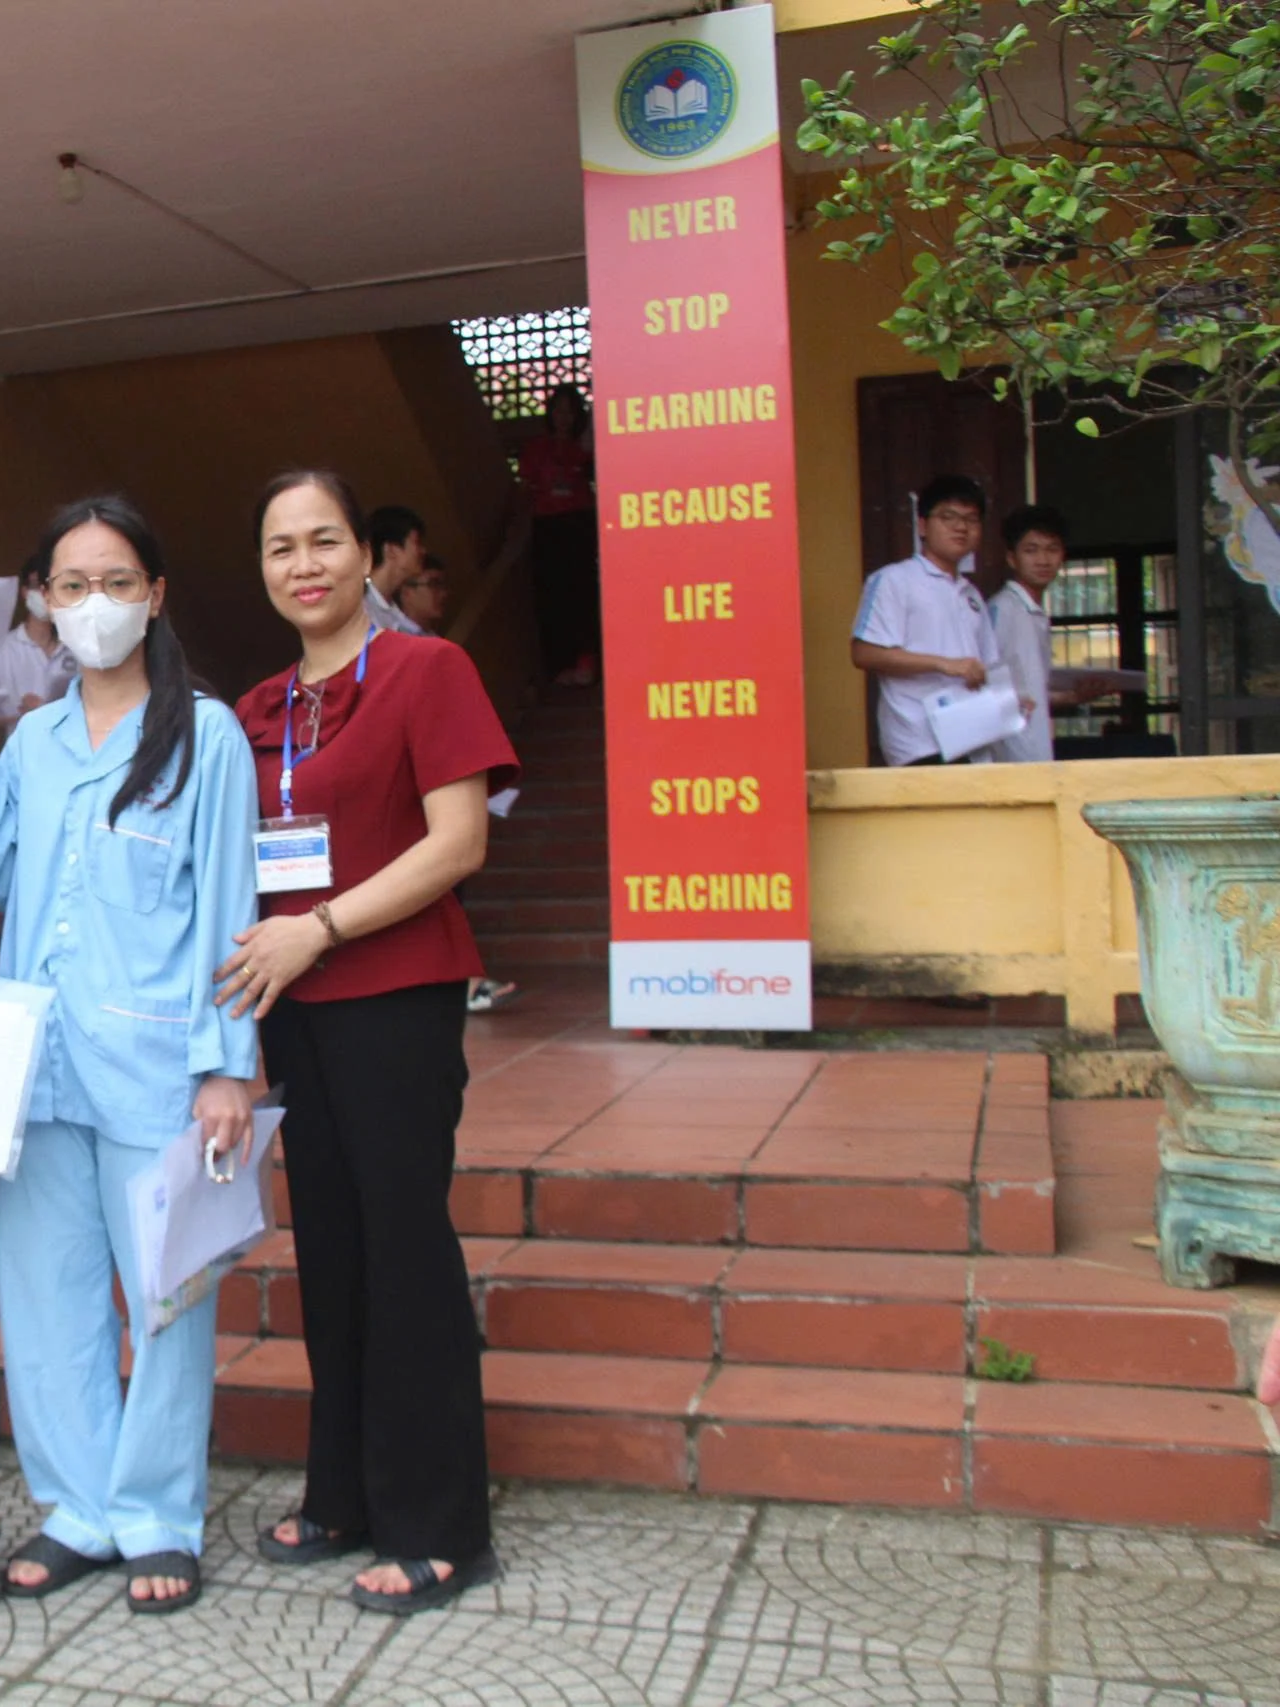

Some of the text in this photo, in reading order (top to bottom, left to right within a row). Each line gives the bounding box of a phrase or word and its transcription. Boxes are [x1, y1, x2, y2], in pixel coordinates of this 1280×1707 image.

[628, 195, 737, 243] NEVER
[644, 292, 730, 336] STOP
[608, 384, 778, 435] LEARNING
[620, 482, 773, 529] BECAUSE
[663, 582, 734, 623] LIFE
[647, 679, 758, 720] NEVER
[650, 776, 761, 817] STOPS
[624, 873, 793, 913] TEACHING
[629, 968, 792, 996] mobifone
